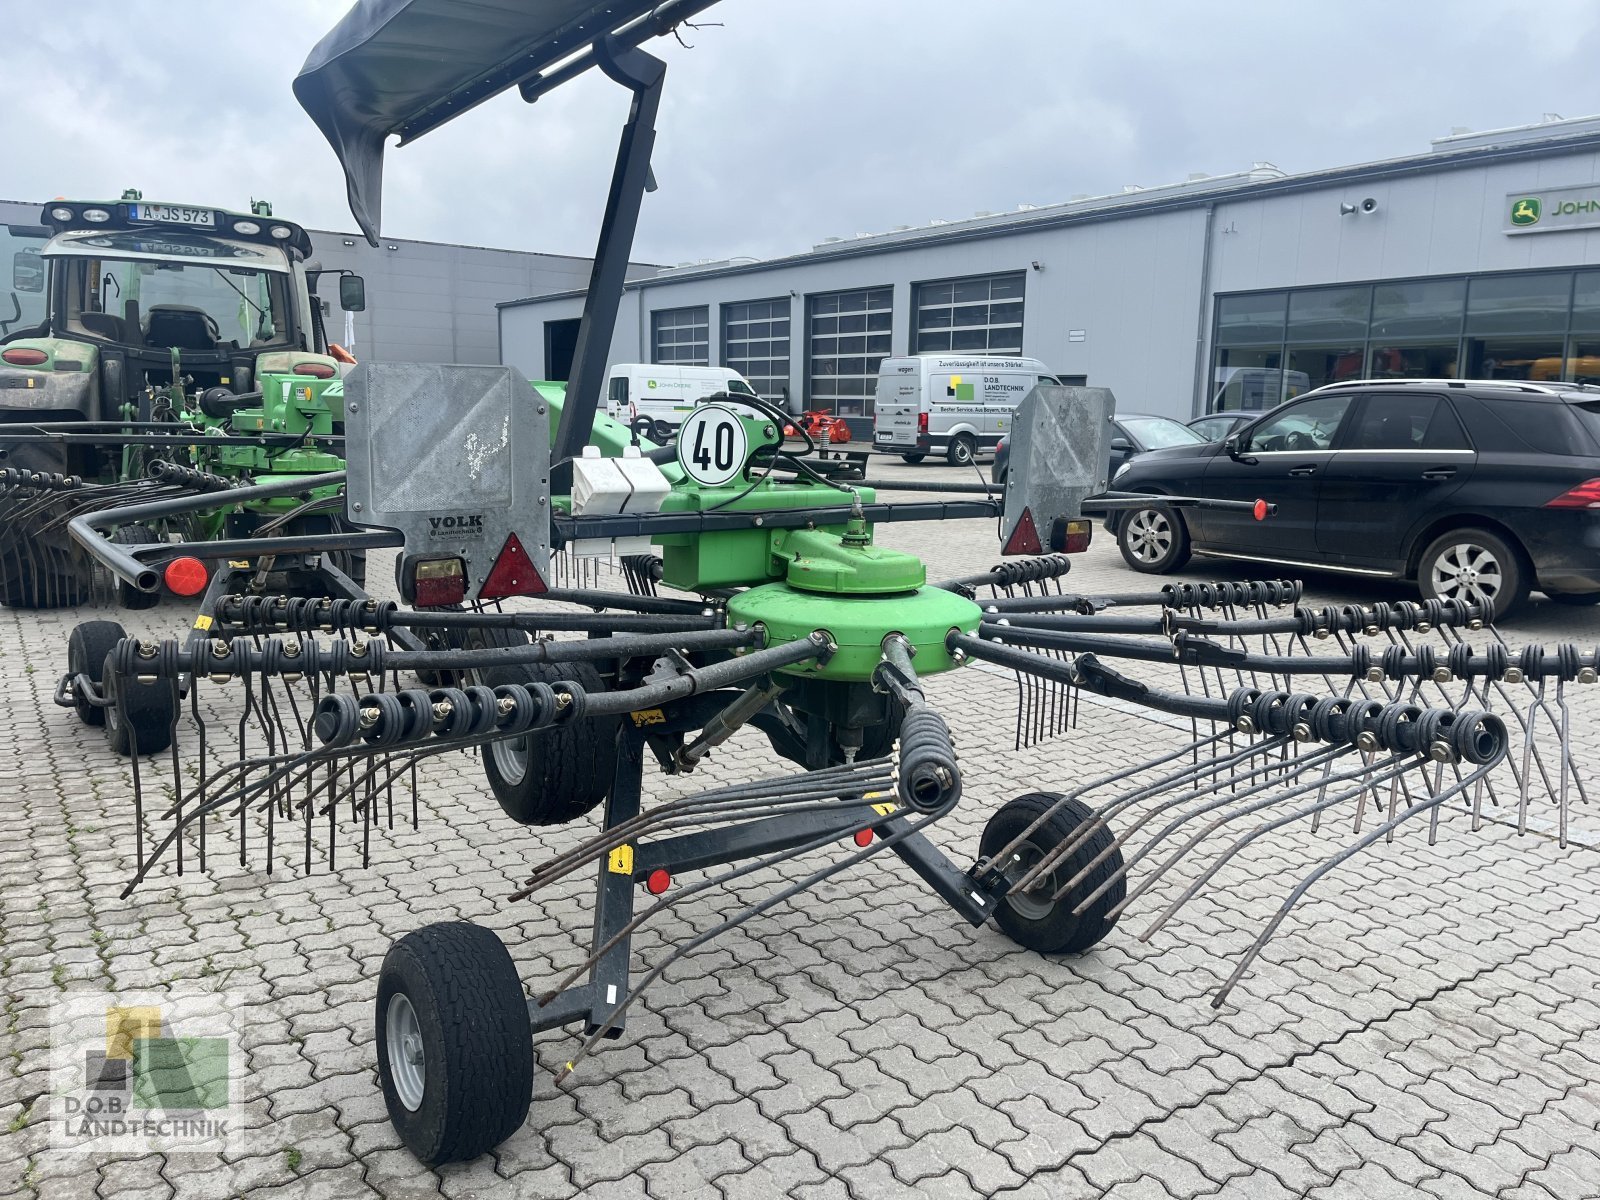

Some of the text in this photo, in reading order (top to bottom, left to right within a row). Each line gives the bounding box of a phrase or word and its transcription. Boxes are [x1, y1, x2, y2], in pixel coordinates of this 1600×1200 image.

[143, 205, 209, 223] A JS 573
[939, 360, 979, 368] Zuverlässigkeit
[693, 420, 734, 471] 40
[429, 515, 482, 529] VOLK
